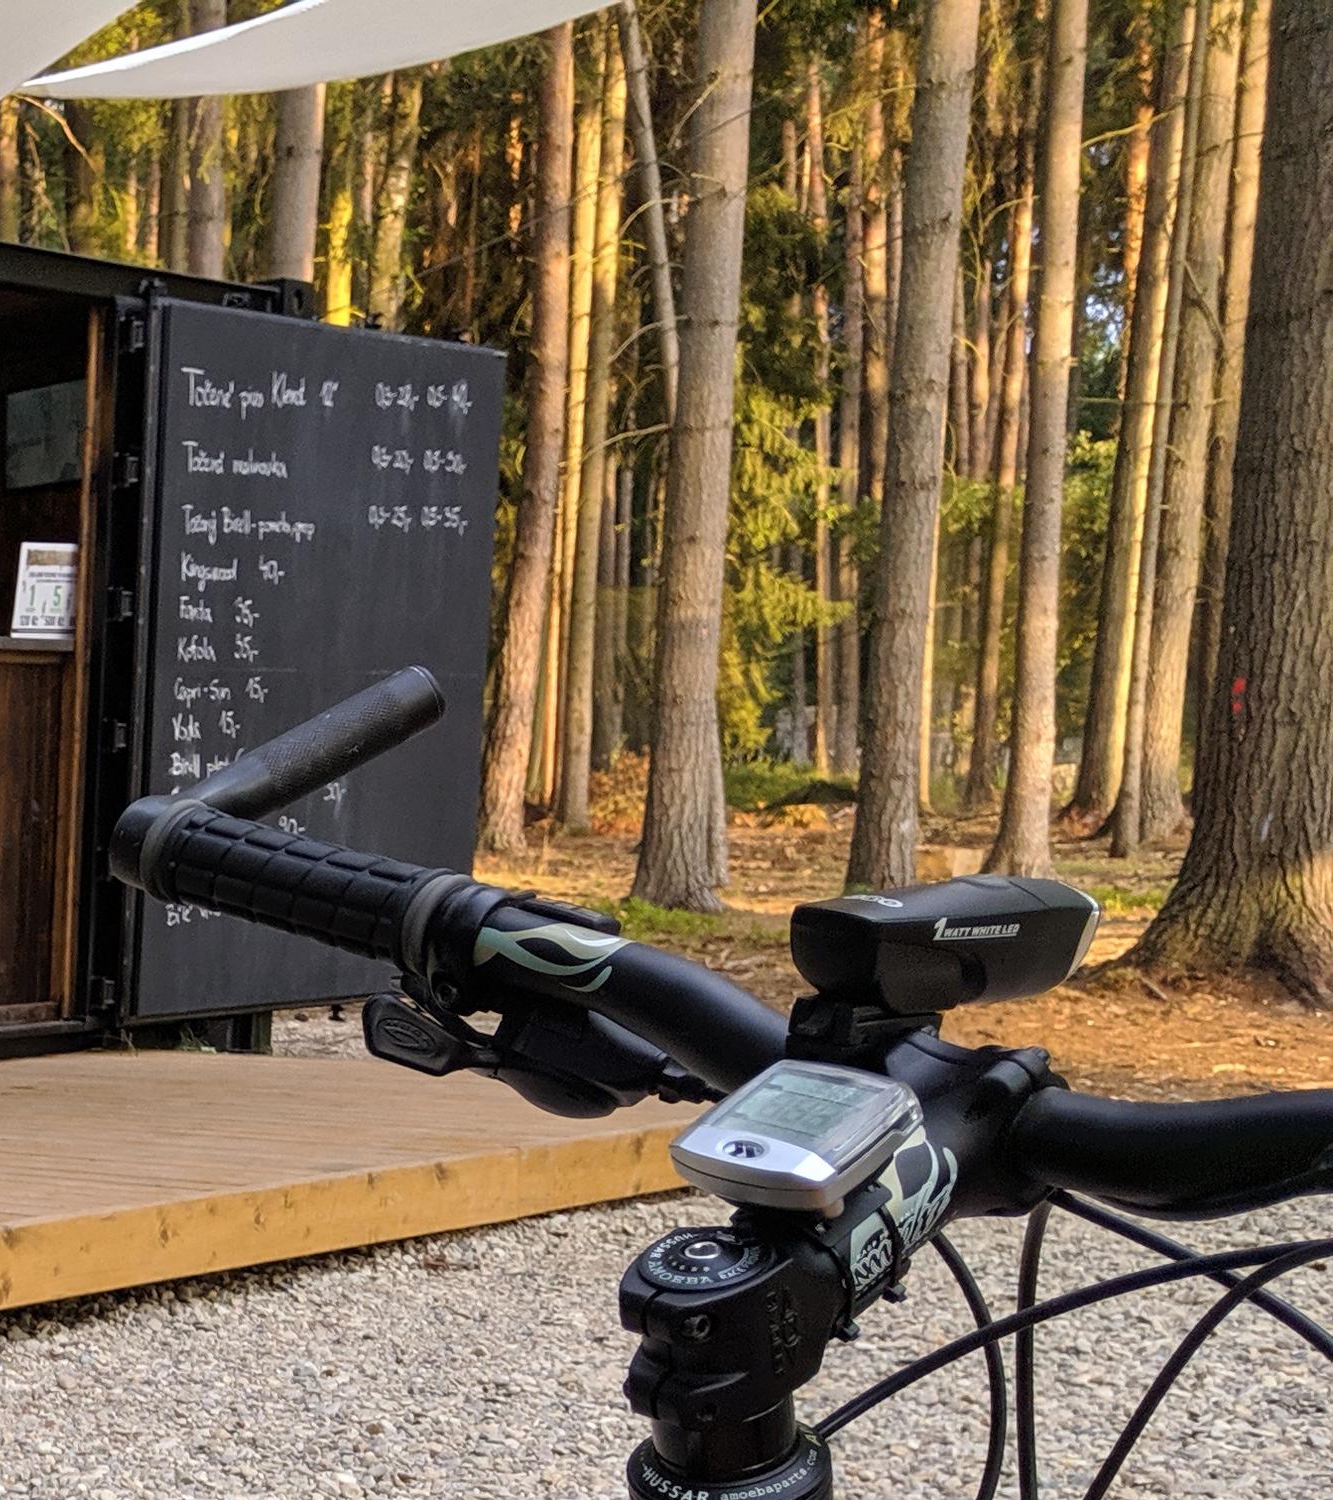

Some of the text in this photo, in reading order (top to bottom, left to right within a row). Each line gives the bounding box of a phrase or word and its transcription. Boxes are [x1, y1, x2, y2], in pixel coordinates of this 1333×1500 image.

[177, 635, 217, 663] Kofola
[944, 927, 972, 937] WATT
[972, 925, 1002, 936] WHITE
[1002, 923, 1020, 934] LED
